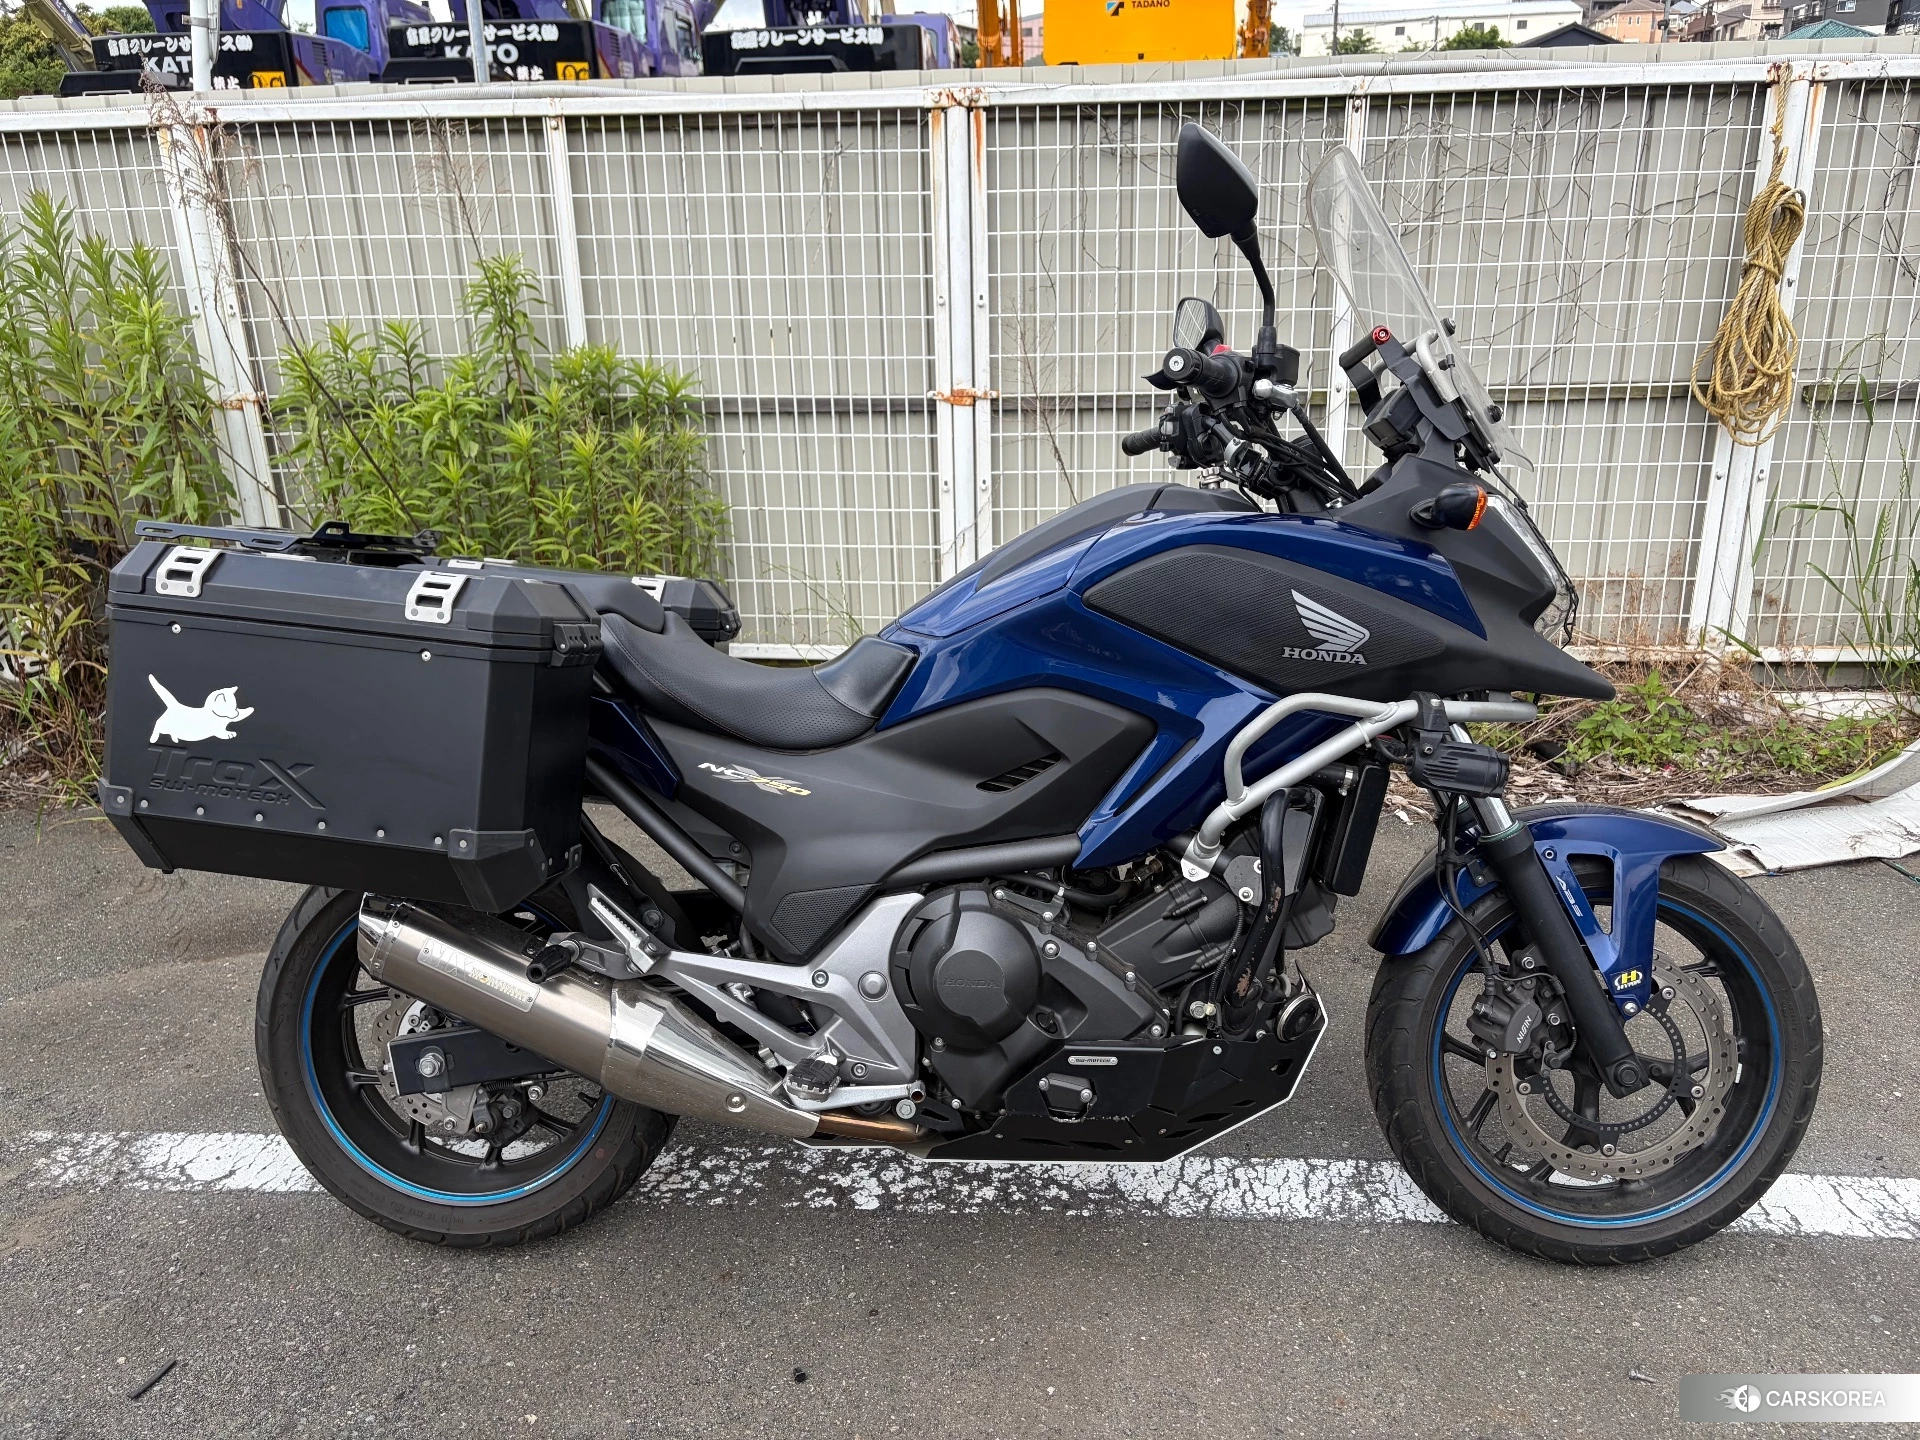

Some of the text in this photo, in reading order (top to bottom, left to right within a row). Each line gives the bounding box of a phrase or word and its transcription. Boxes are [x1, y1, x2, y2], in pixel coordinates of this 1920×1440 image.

[1132, 0, 1170, 8] TADANO
[145, 56, 192, 73] KAT
[1282, 646, 1367, 665] HONDA
[149, 777, 293, 806] SW-MOTECH
[1555, 875, 1583, 917] ABS
[943, 978, 1000, 989] HONDA
